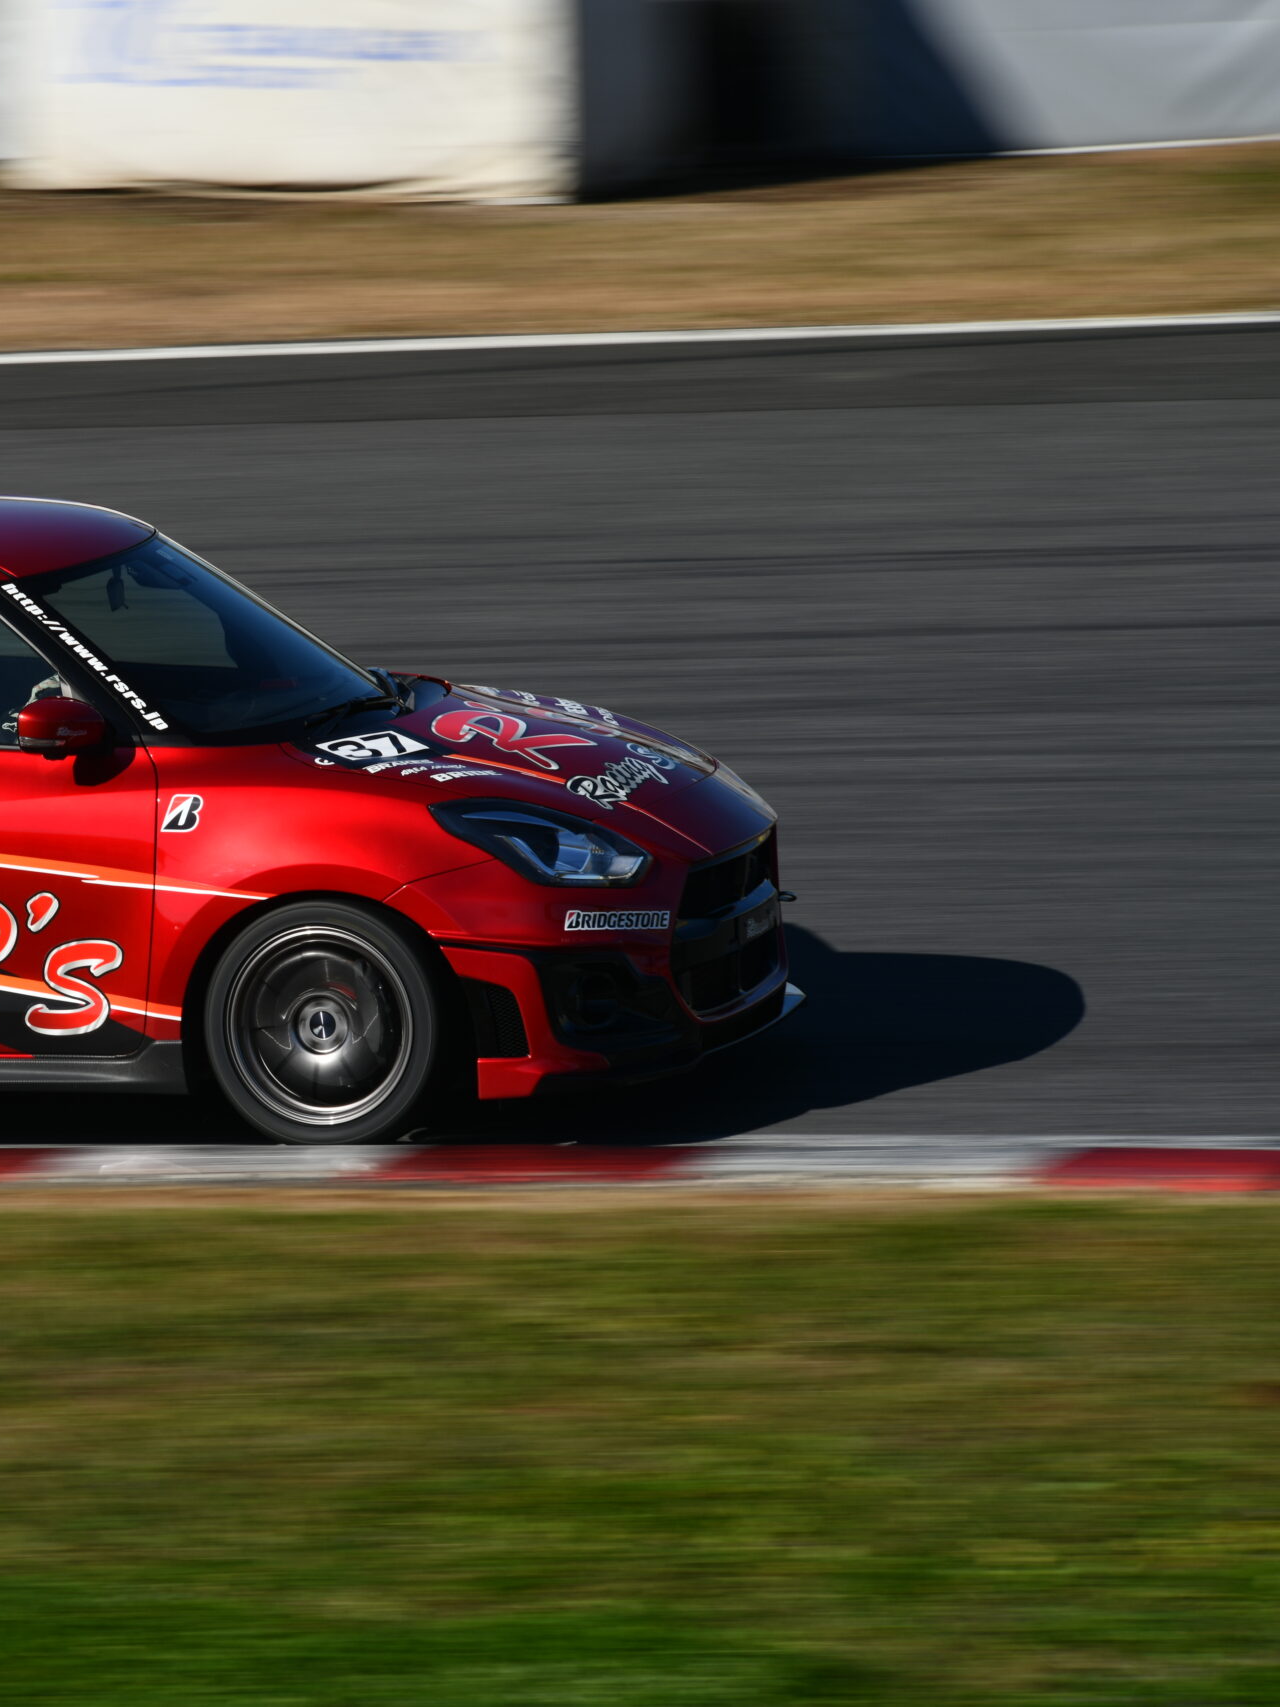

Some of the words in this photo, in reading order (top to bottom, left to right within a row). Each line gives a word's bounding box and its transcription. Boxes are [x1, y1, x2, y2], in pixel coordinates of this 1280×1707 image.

[327, 732, 408, 758] 37
[429, 770, 503, 782] BRIDE
[565, 911, 669, 930] BRIDGESTONE
